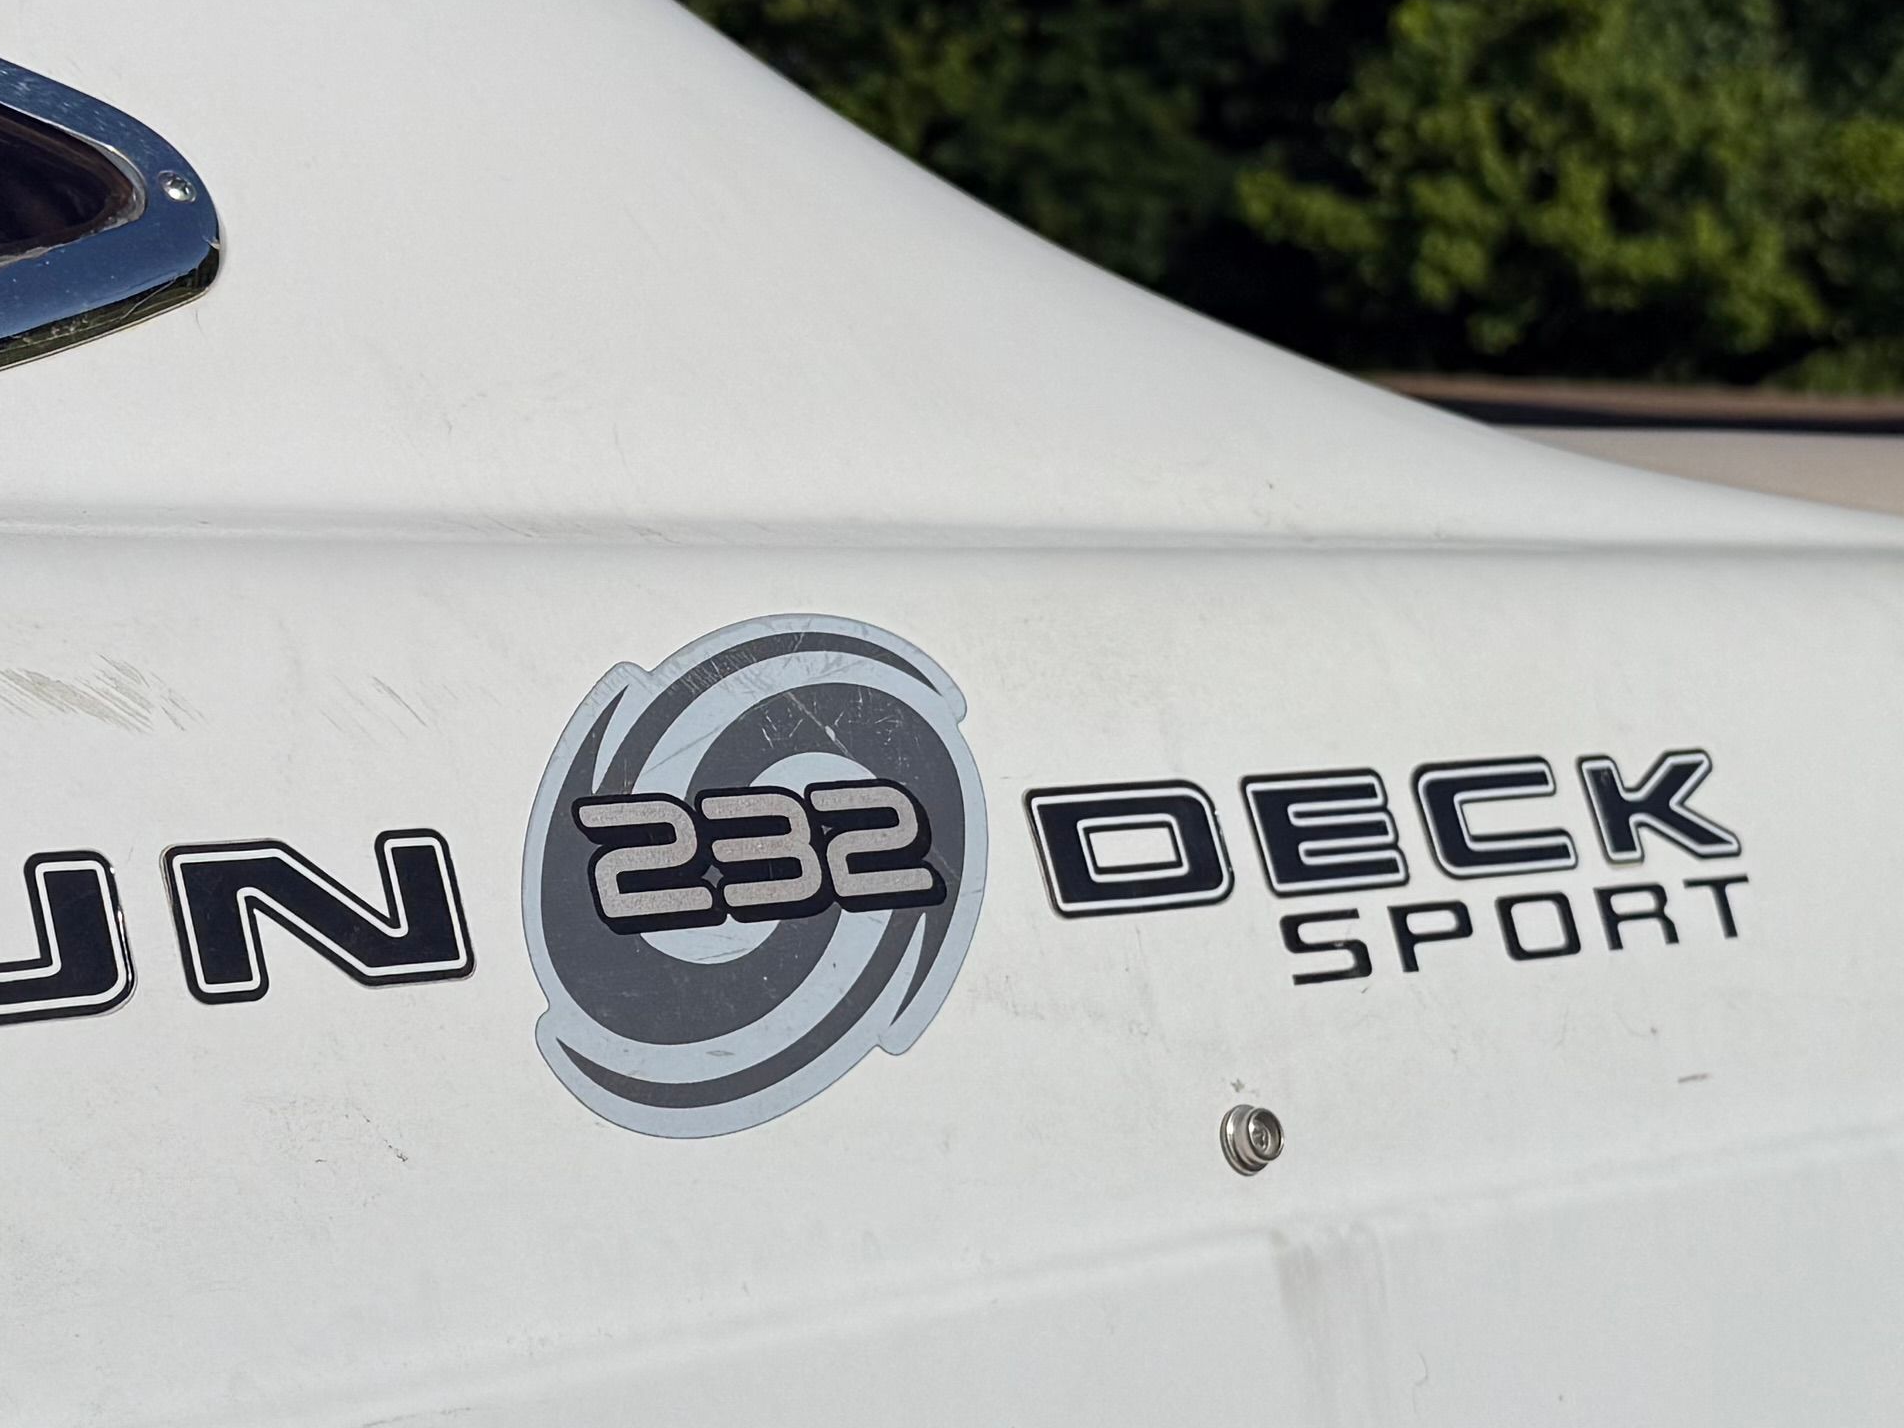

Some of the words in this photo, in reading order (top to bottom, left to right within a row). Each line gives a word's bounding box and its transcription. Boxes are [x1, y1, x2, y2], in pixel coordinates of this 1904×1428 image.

[572, 778, 946, 934] 232
[1023, 747, 1741, 920] DECK
[1278, 874, 1750, 985] SPORT
